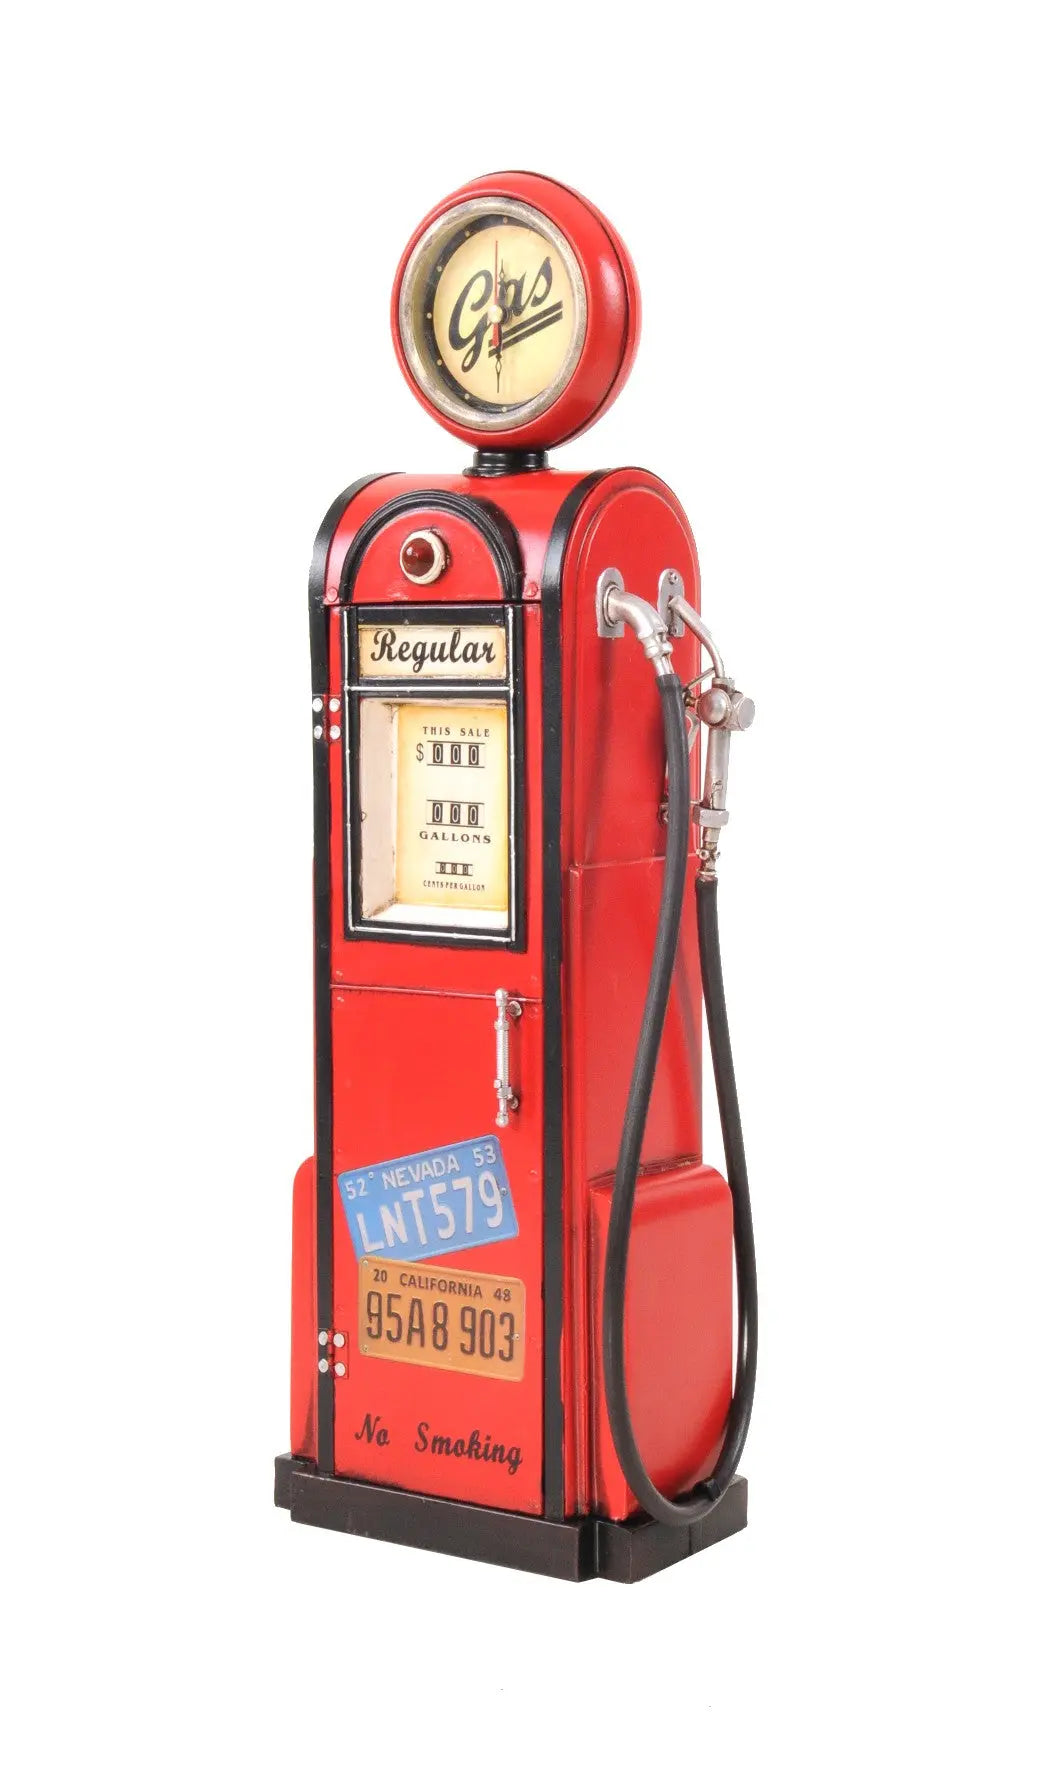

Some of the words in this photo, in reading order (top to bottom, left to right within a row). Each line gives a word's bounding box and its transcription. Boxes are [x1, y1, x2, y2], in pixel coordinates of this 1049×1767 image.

[448, 256, 553, 373] Gas
[370, 628, 496, 673] Regular
[423, 726, 451, 736] THIS
[460, 727, 490, 737] SALE
[419, 830, 491, 844] GALLONS
[423, 879, 444, 888] CENTS
[445, 881, 458, 890] PER
[459, 882, 486, 892] GALLON
[344, 1177, 368, 1200] 52
[381, 1154, 460, 1190] NEVADA
[472, 1143, 497, 1167] 53
[356, 1169, 504, 1253] LNT579
[373, 1268, 388, 1283] 20
[399, 1272, 483, 1298] CALIFORNIA
[493, 1288, 512, 1302] 48
[354, 1413, 390, 1447] No
[414, 1421, 524, 1476] Smoking
